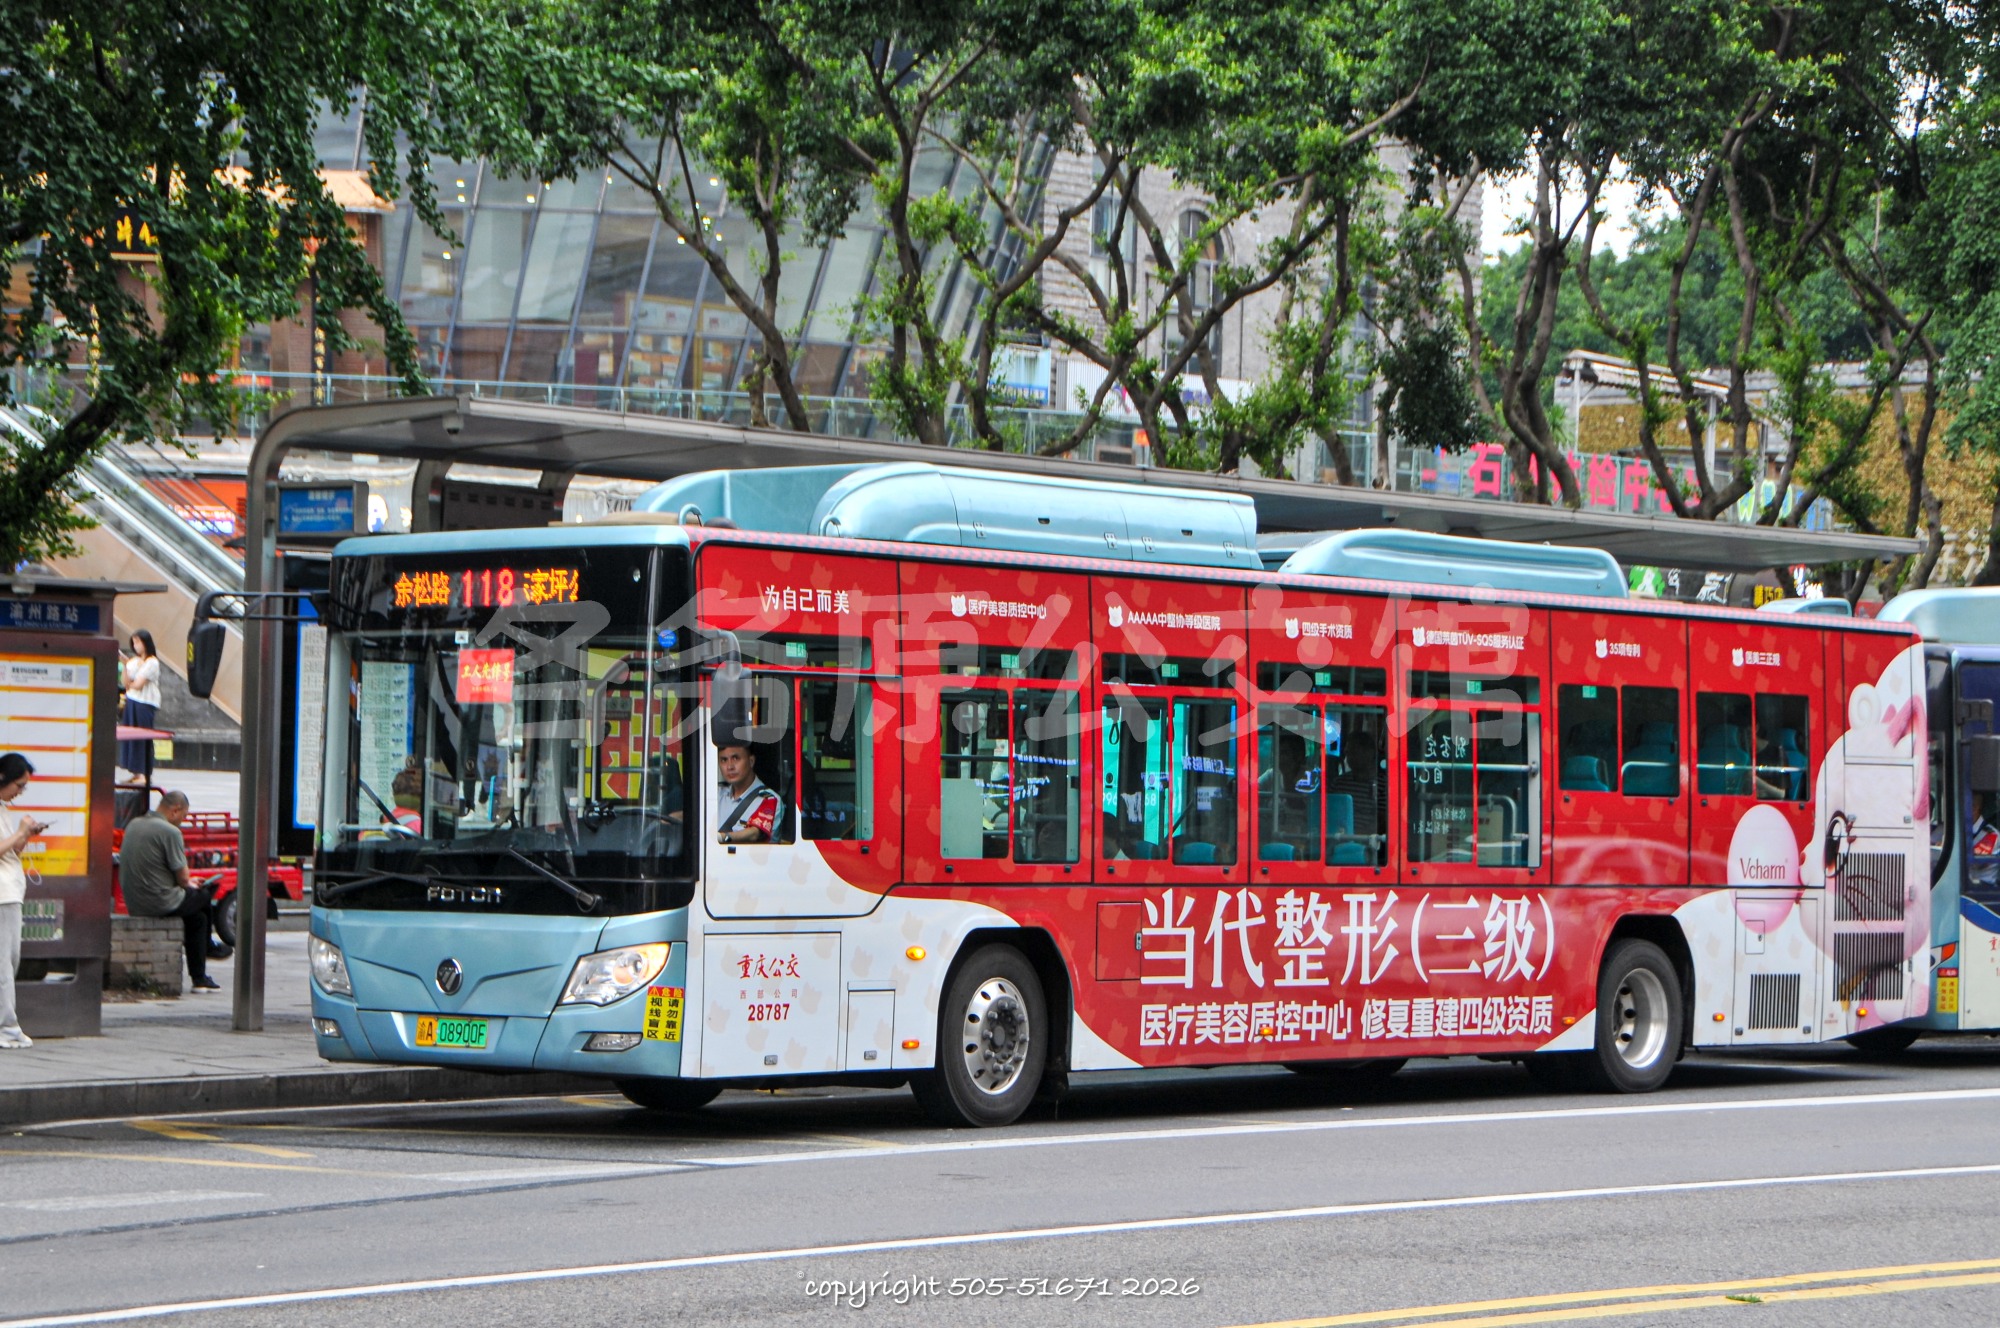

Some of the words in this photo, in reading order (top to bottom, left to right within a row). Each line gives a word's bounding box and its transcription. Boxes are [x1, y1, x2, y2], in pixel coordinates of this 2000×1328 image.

[394, 571, 451, 608] 余松路
[461, 569, 515, 608] 118
[758, 583, 850, 615] 为自己而美
[968, 599, 1047, 620] 医疗美容质控中心
[1302, 621, 1353, 640] 四级手术资质
[1609, 642, 1641, 658] 35项专利
[1739, 857, 1786, 880] Vcharm
[1141, 887, 1556, 989] 当代整形(三级)
[737, 953, 801, 979] 重庆公交
[748, 1003, 790, 1021] 28787
[1140, 1000, 1351, 1047] 医疗美容质控中心
[1360, 995, 1553, 1041] 修复重建四级资质
